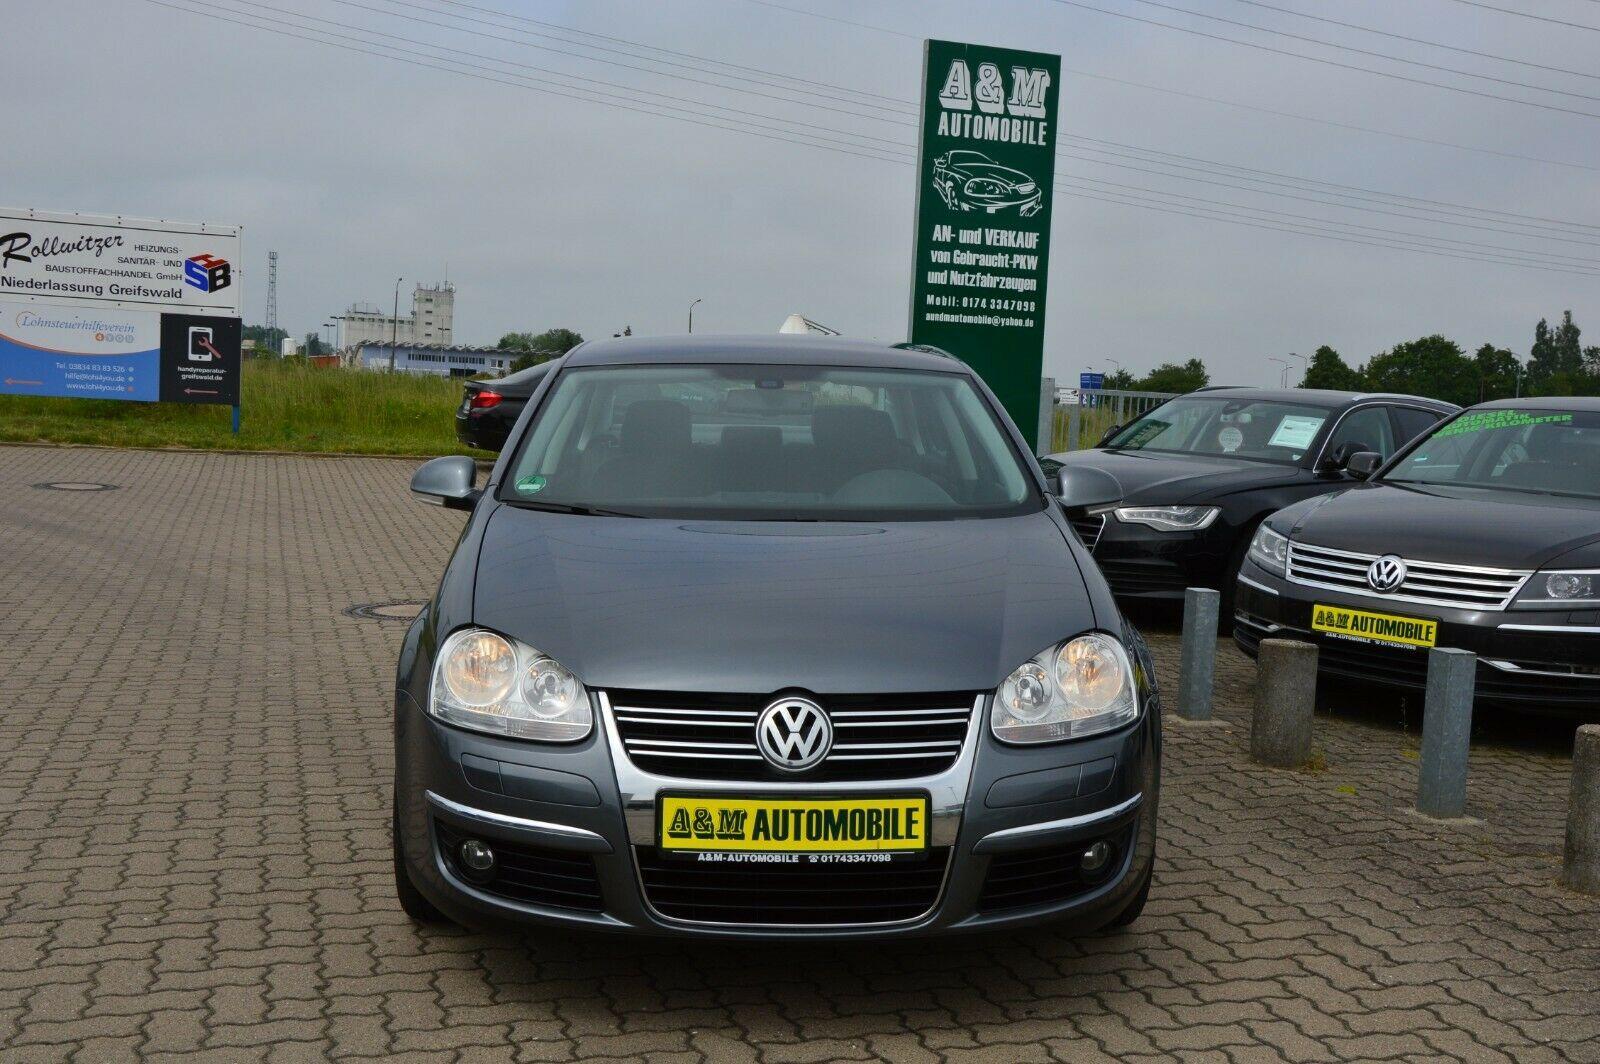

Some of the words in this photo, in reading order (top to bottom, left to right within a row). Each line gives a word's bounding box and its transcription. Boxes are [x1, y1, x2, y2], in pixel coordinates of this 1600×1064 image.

[939, 58, 1051, 119] A&M
[937, 111, 1048, 146] AUTOMOBILE
[932, 224, 956, 243] AN-
[958, 227, 983, 245] und
[984, 228, 1040, 250] VERKAUF
[0, 232, 125, 269] Rollwitzer
[134, 244, 183, 255] HEIZUNGS-
[930, 249, 951, 264] von
[952, 249, 1039, 271] Gebraucht-PKW
[45, 264, 152, 280] BAUSTOFFFACHHANDEL
[155, 272, 183, 282] GmbH
[163, 260, 183, 268] UND
[1, 275, 103, 297] Niederlassung
[108, 283, 183, 300] Greifswald
[927, 269, 948, 285] und
[949, 269, 1037, 293] Nutzfahrzeugen
[926, 294, 960, 308] Mobil:
[962, 296, 987, 310] 0174
[989, 298, 1037, 313] 3347098
[22, 315, 135, 334] Lohnsteuerhilfeverein
[1350, 614, 1434, 643] AUTOMOBILE
[668, 807, 748, 841] A&M
[751, 806, 920, 842] AUTOMOBILE
[697, 853, 800, 864] A&M-AUTOMOBILE
[820, 853, 892, 863] 01743347098
